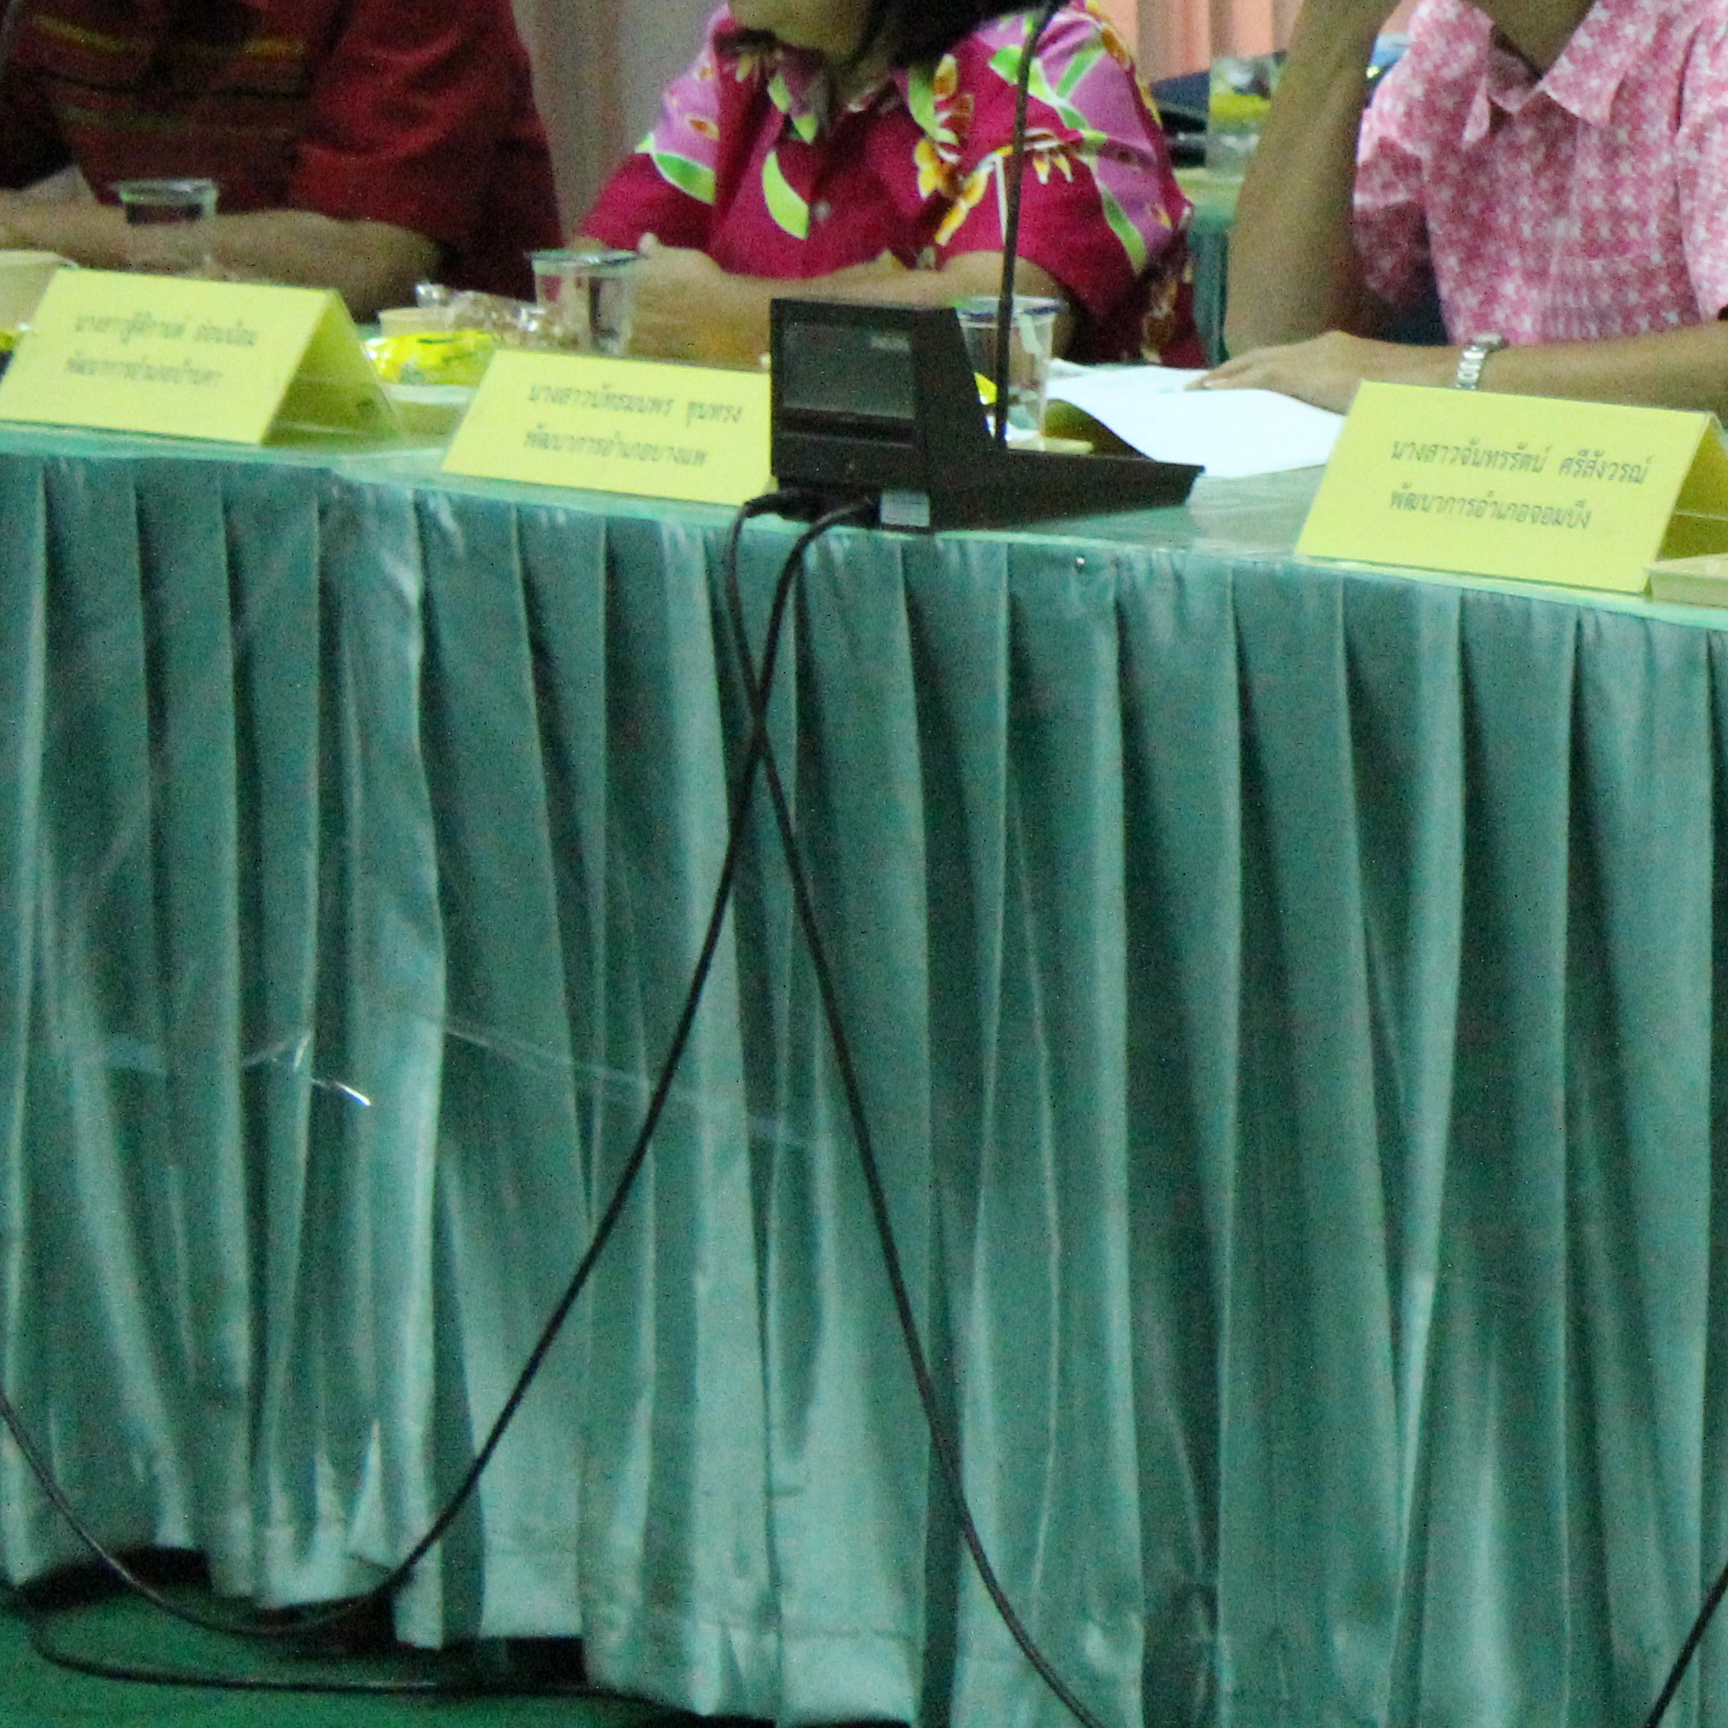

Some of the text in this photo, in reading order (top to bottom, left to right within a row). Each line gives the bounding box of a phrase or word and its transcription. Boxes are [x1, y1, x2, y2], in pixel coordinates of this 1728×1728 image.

[1390, 481, 1592, 530] พัฒนาการอำเภอจอมบึง
